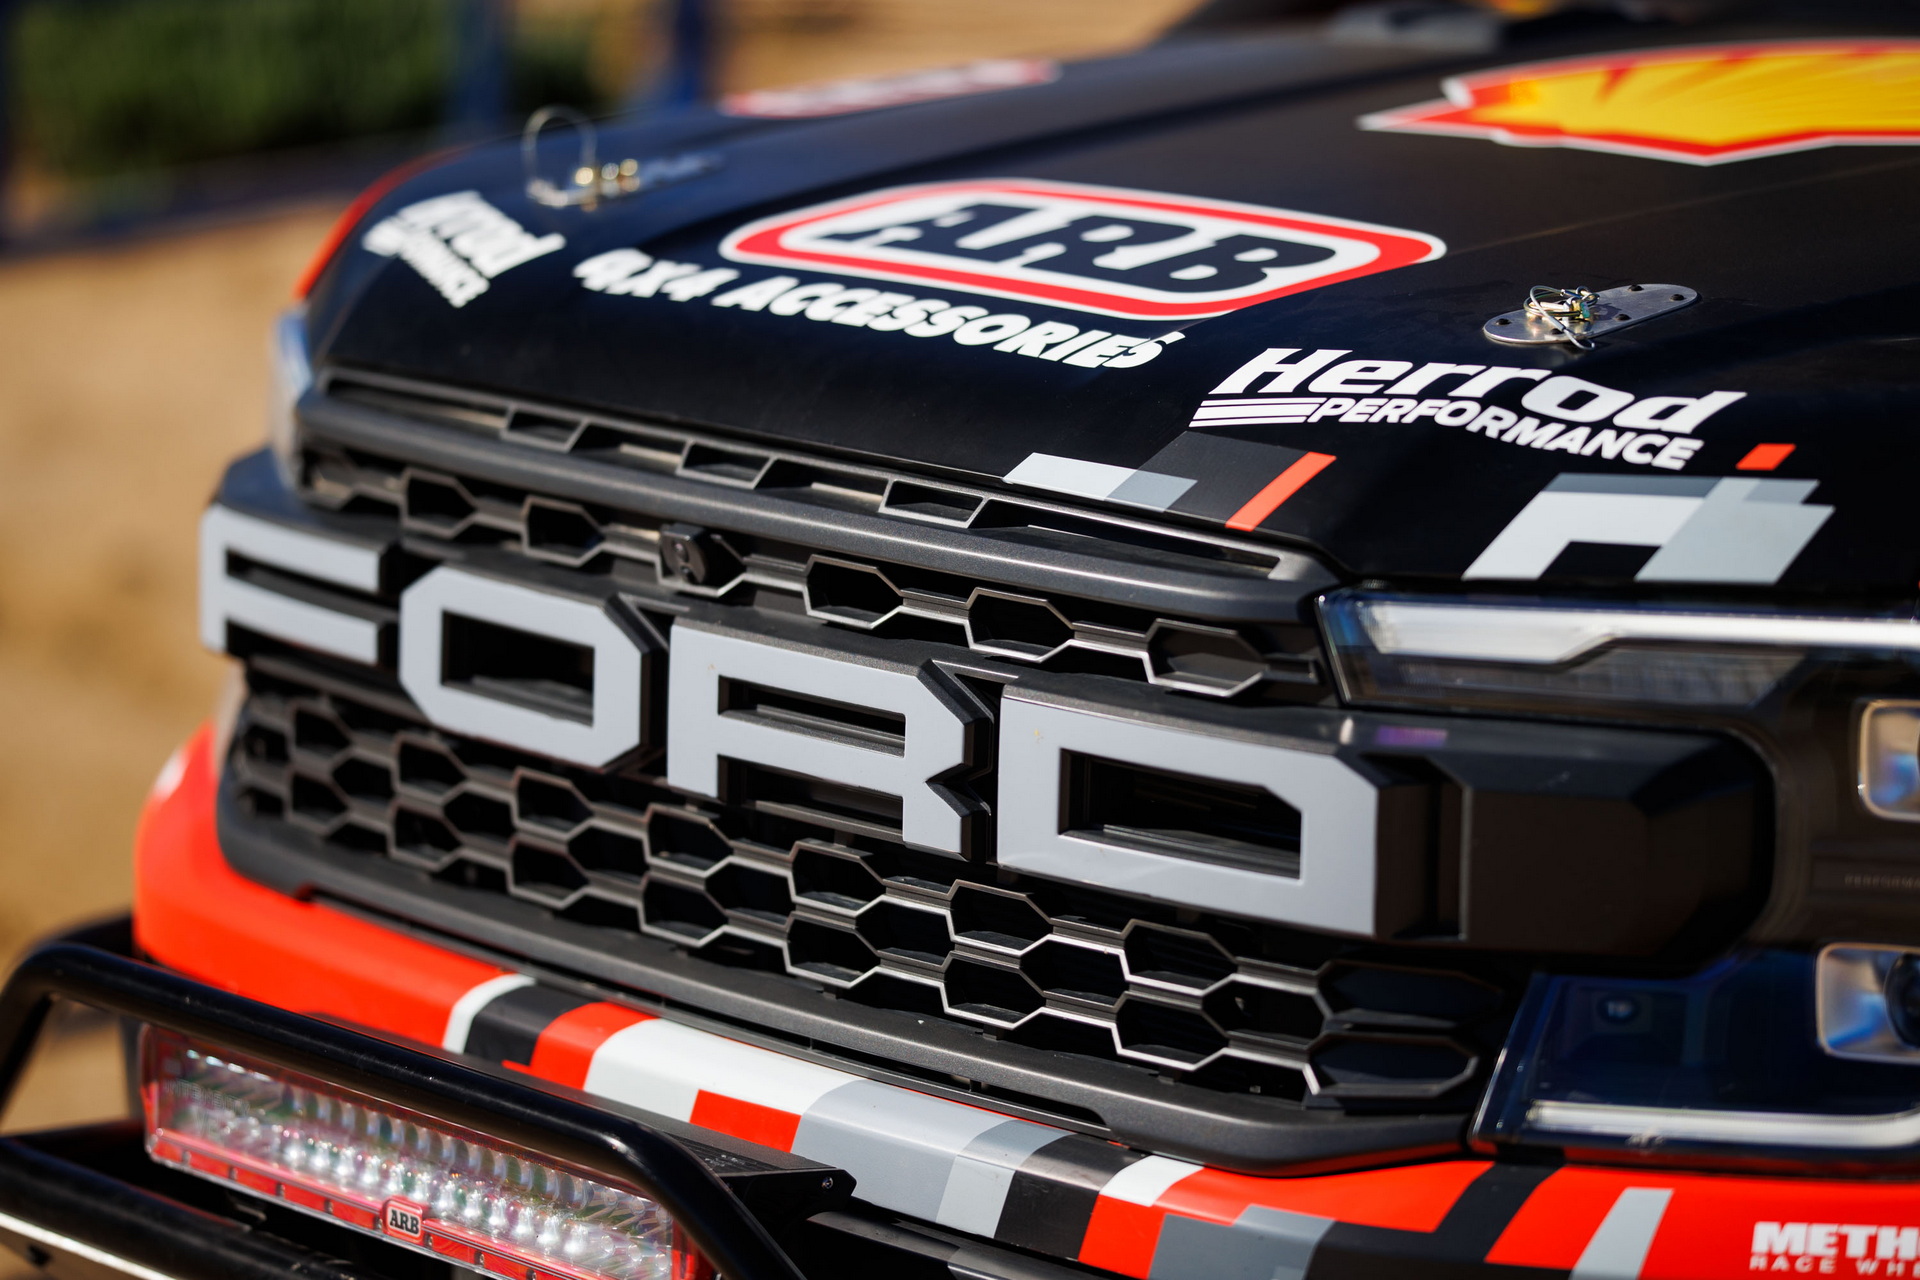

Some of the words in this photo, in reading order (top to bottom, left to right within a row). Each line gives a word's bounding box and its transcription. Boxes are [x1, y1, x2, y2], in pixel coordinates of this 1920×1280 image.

[818, 202, 1337, 293] ARB
[711, 276, 1187, 369] ACCESSORIES
[1207, 348, 1747, 434] Herrod
[1308, 397, 1704, 469] PERFORMANCE
[199, 501, 1380, 937] FORD
[390, 1209, 419, 1235] ARB
[1751, 1221, 1920, 1260] METH
[1749, 1254, 1838, 1274] RACE
